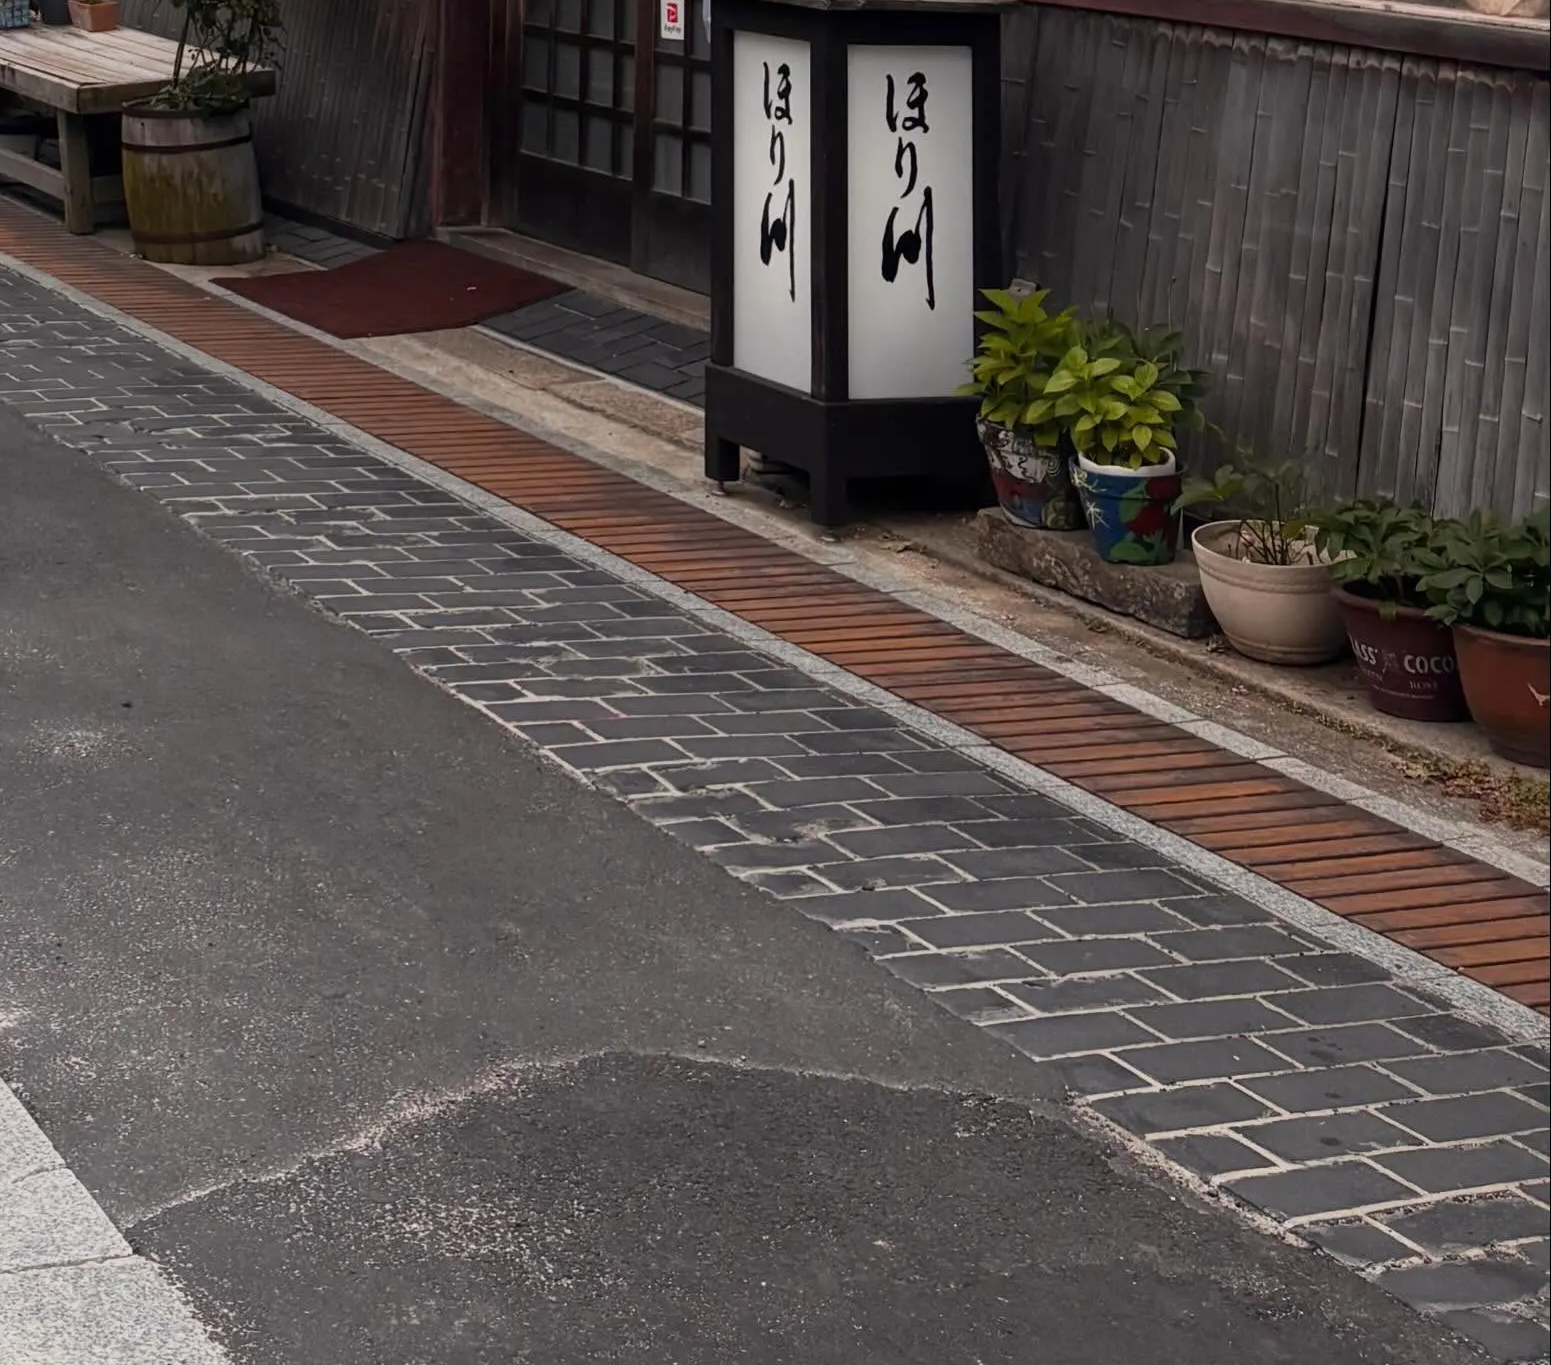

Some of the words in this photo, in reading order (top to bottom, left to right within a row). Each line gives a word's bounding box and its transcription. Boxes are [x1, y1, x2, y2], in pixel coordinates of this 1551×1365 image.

[760, 61, 796, 303] ほり川
[881, 72, 936, 311] ほり川
